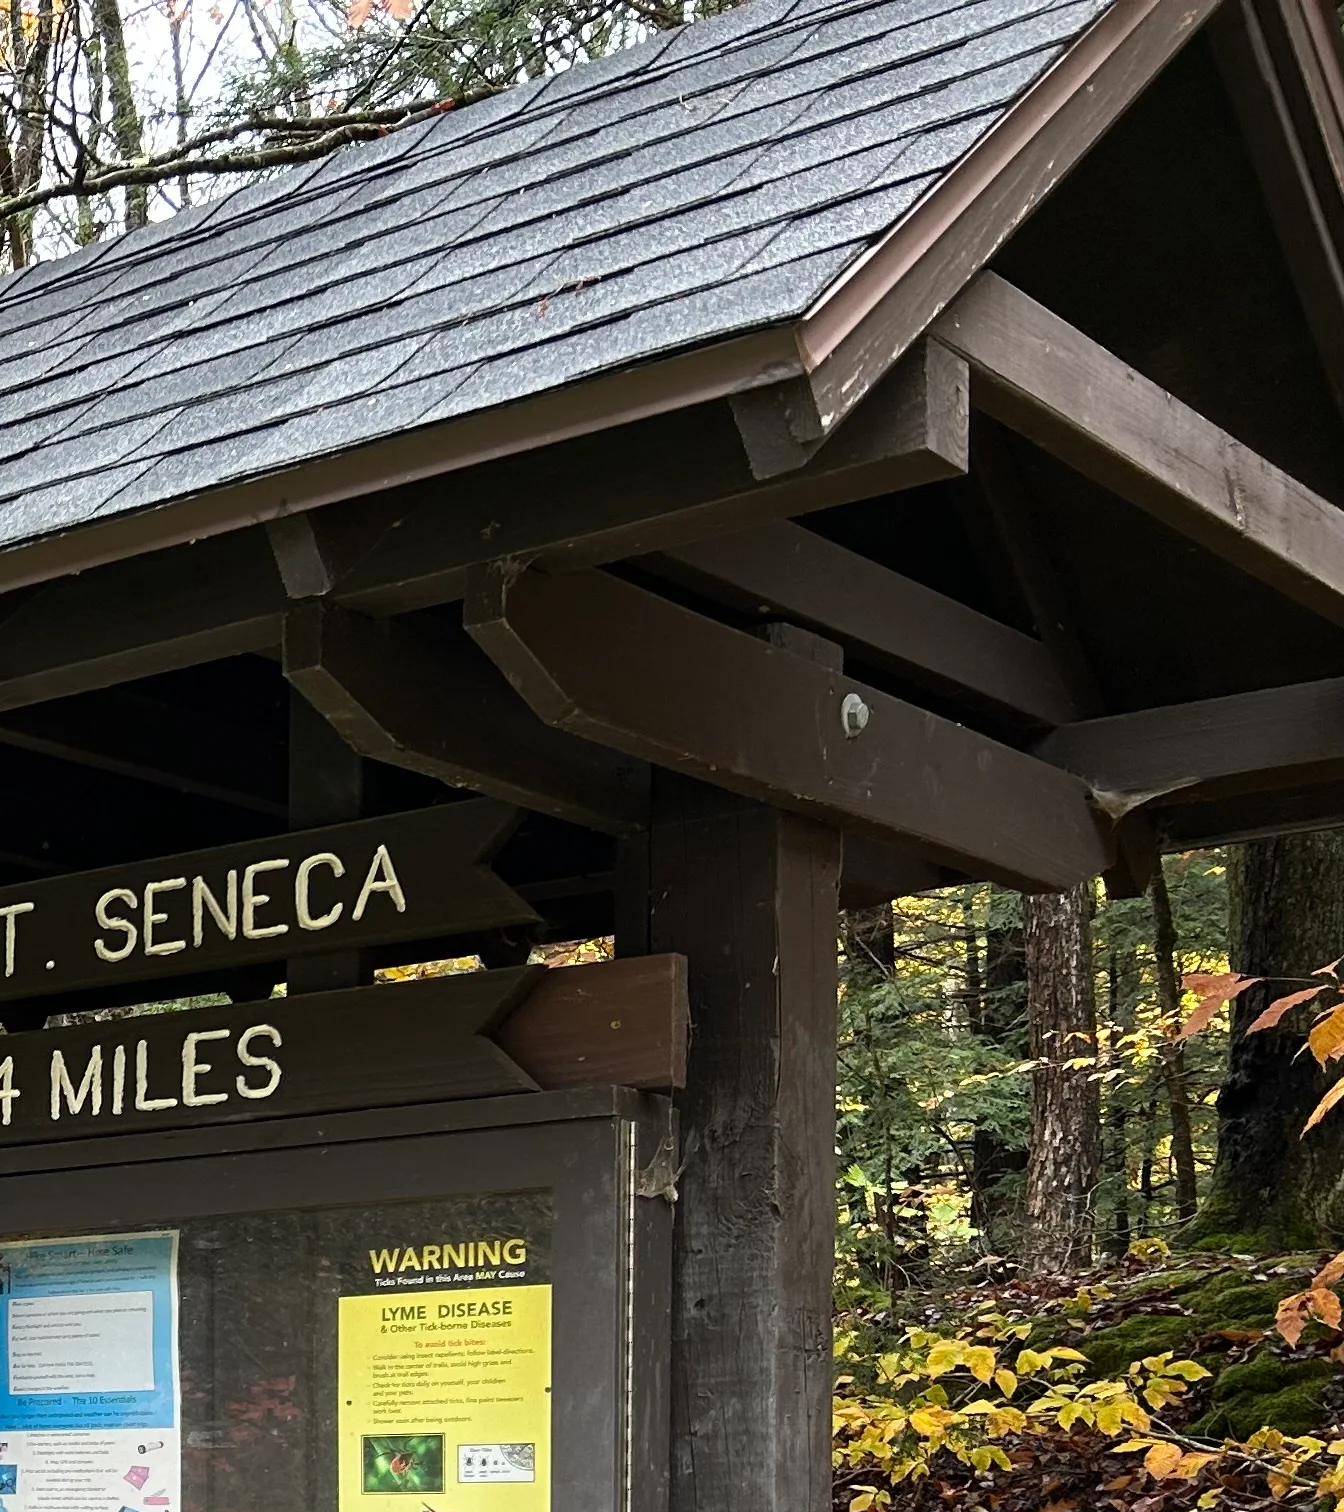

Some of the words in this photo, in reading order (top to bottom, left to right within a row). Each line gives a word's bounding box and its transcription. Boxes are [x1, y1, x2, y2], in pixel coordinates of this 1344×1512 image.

[94, 844, 406, 963] SENECA
[50, 1024, 282, 1120] MILES
[112, 1244, 133, 1256] Safe
[369, 1239, 526, 1274] WARNING
[397, 1276, 424, 1285] Found
[436, 1274, 451, 1283] this
[476, 1271, 497, 1280] MAY
[498, 1270, 526, 1279] Cause
[382, 1305, 426, 1322] LYME
[438, 1300, 512, 1318] DISEASE
[380, 1325, 387, 1333] &
[390, 1324, 417, 1333] Other
[419, 1322, 468, 1331] Tick-borne
[471, 1320, 512, 1329] Diseases
